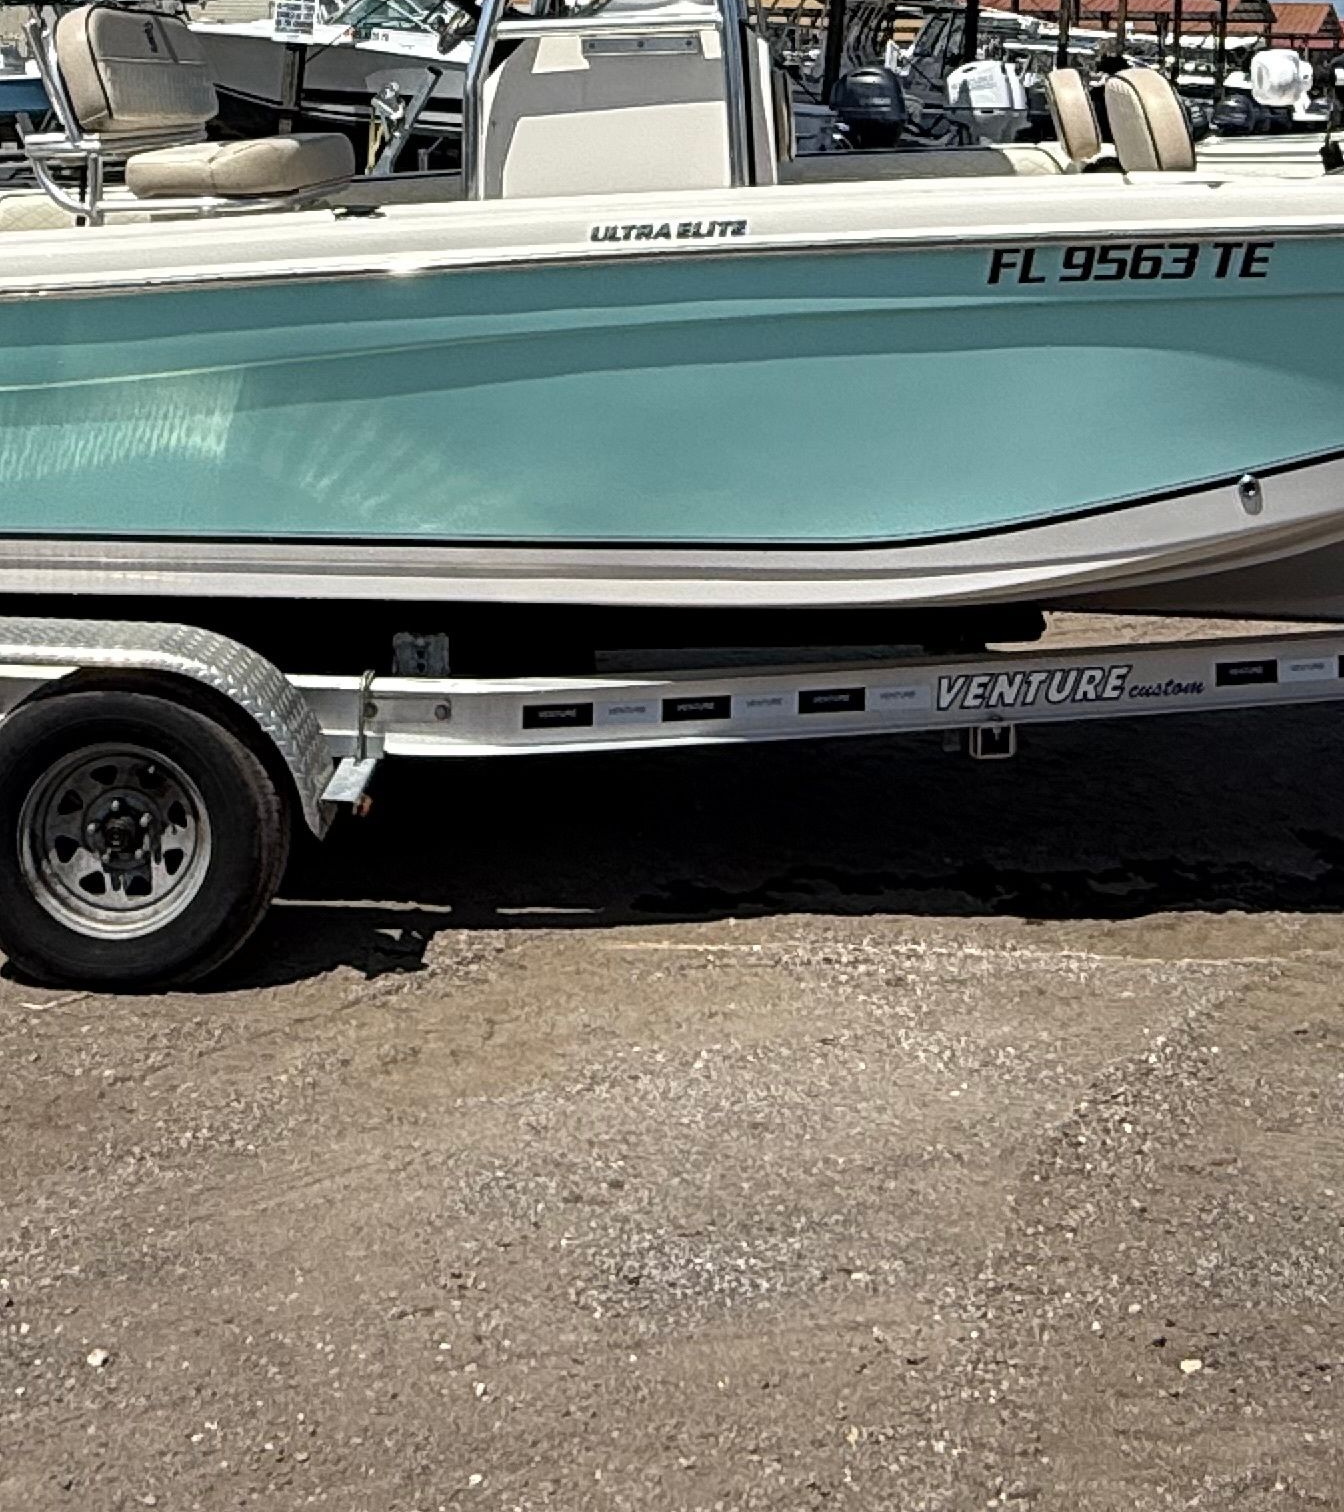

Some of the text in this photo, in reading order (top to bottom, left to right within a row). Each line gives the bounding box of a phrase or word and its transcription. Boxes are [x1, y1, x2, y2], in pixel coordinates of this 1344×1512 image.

[590, 219, 747, 241] ULTRA ELITE
[987, 241, 1275, 284] FL 9563 TE
[937, 665, 1204, 710] VENTURE custom
